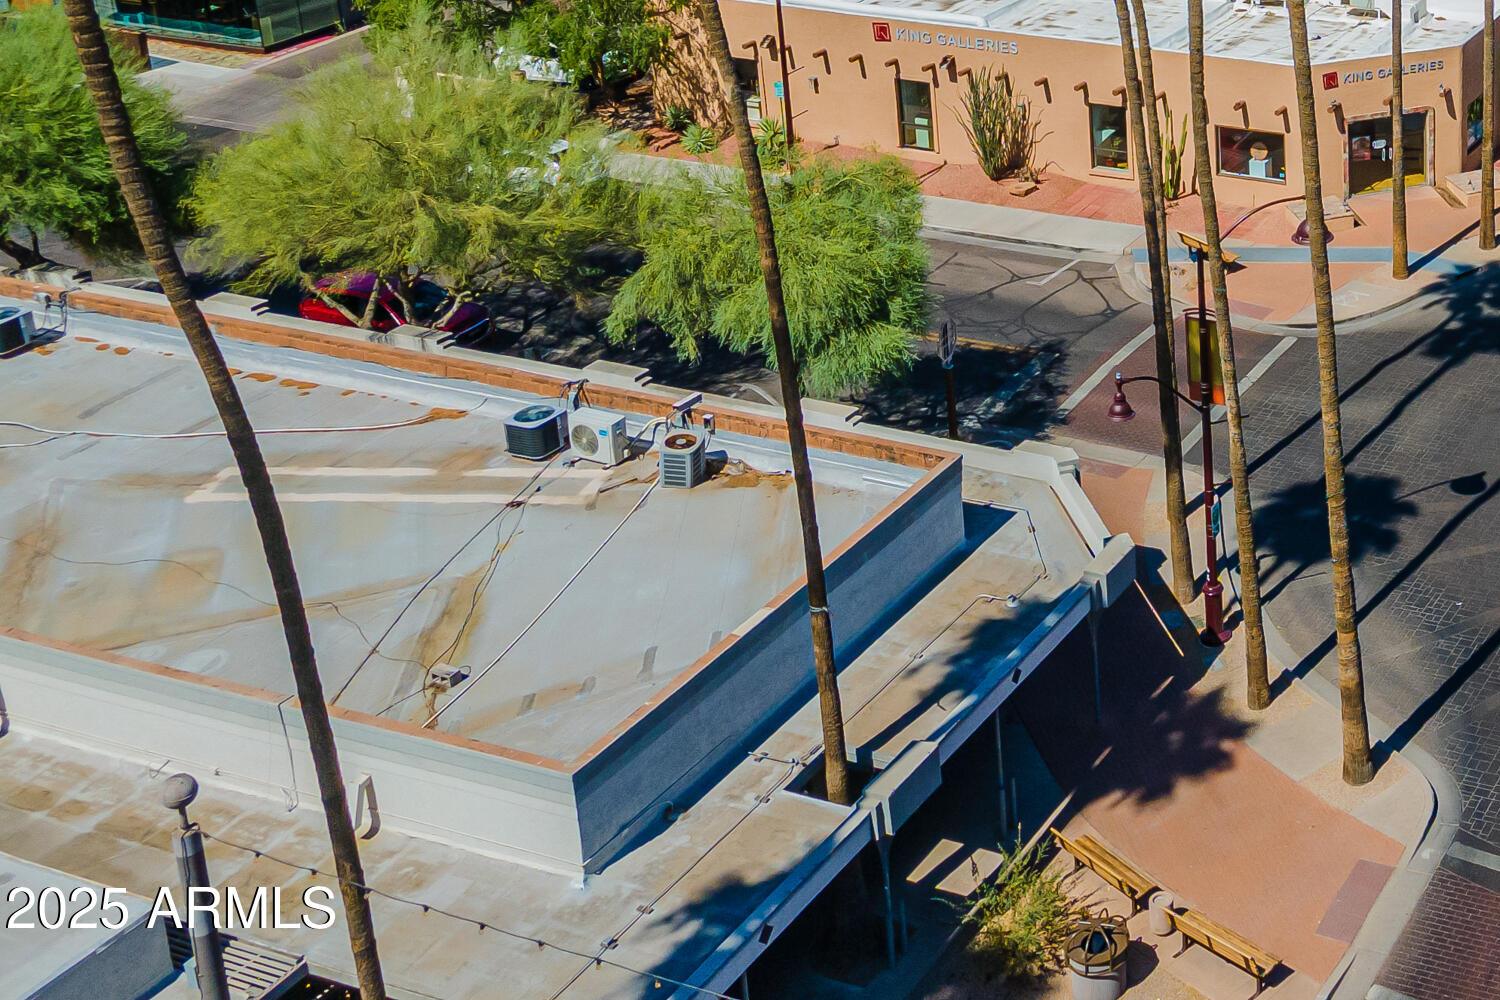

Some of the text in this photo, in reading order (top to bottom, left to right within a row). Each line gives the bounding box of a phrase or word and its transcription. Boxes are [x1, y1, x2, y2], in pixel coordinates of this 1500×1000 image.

[895, 28, 1018, 54] KING GALLERIES
[1343, 61, 1444, 85] KING GALERIES
